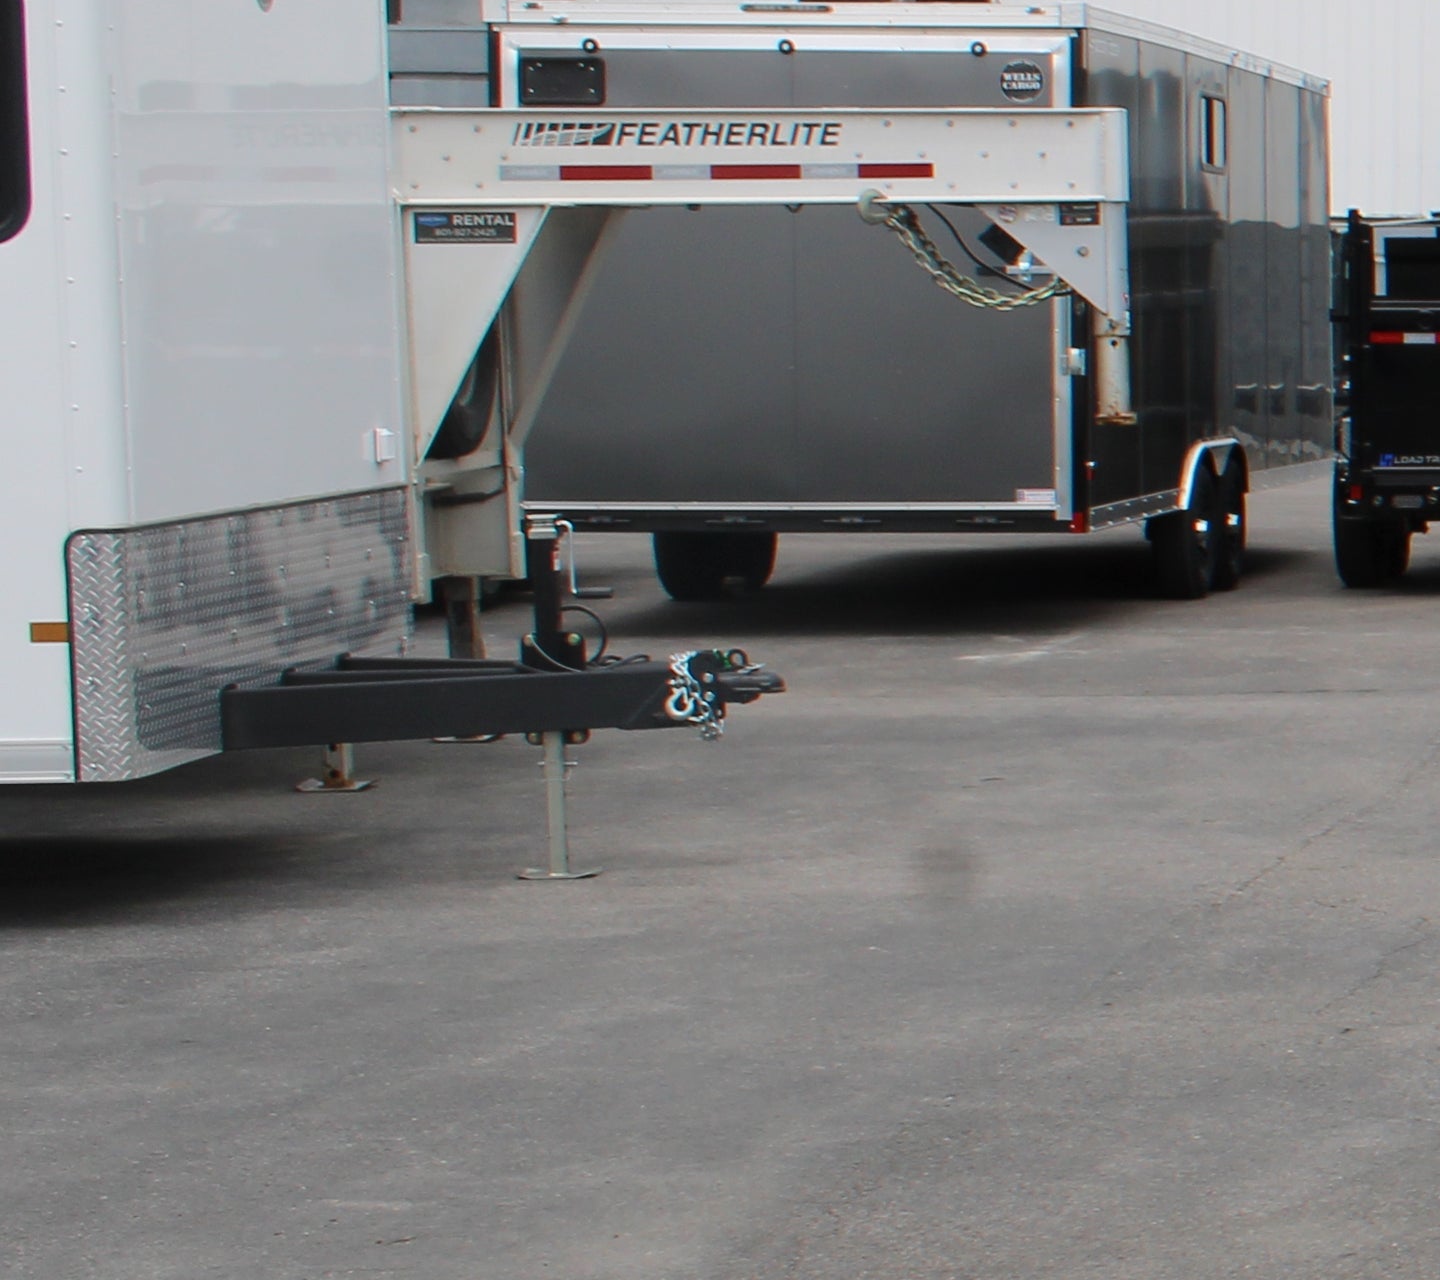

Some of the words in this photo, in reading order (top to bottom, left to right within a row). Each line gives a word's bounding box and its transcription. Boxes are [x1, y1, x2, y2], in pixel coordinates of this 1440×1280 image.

[1002, 72, 1041, 81] WELLS
[1002, 81, 1041, 90] CARGO
[615, 122, 842, 147] FEATHERLITE
[452, 214, 515, 226] RENTAL
[1394, 455, 1424, 464] LOAD
